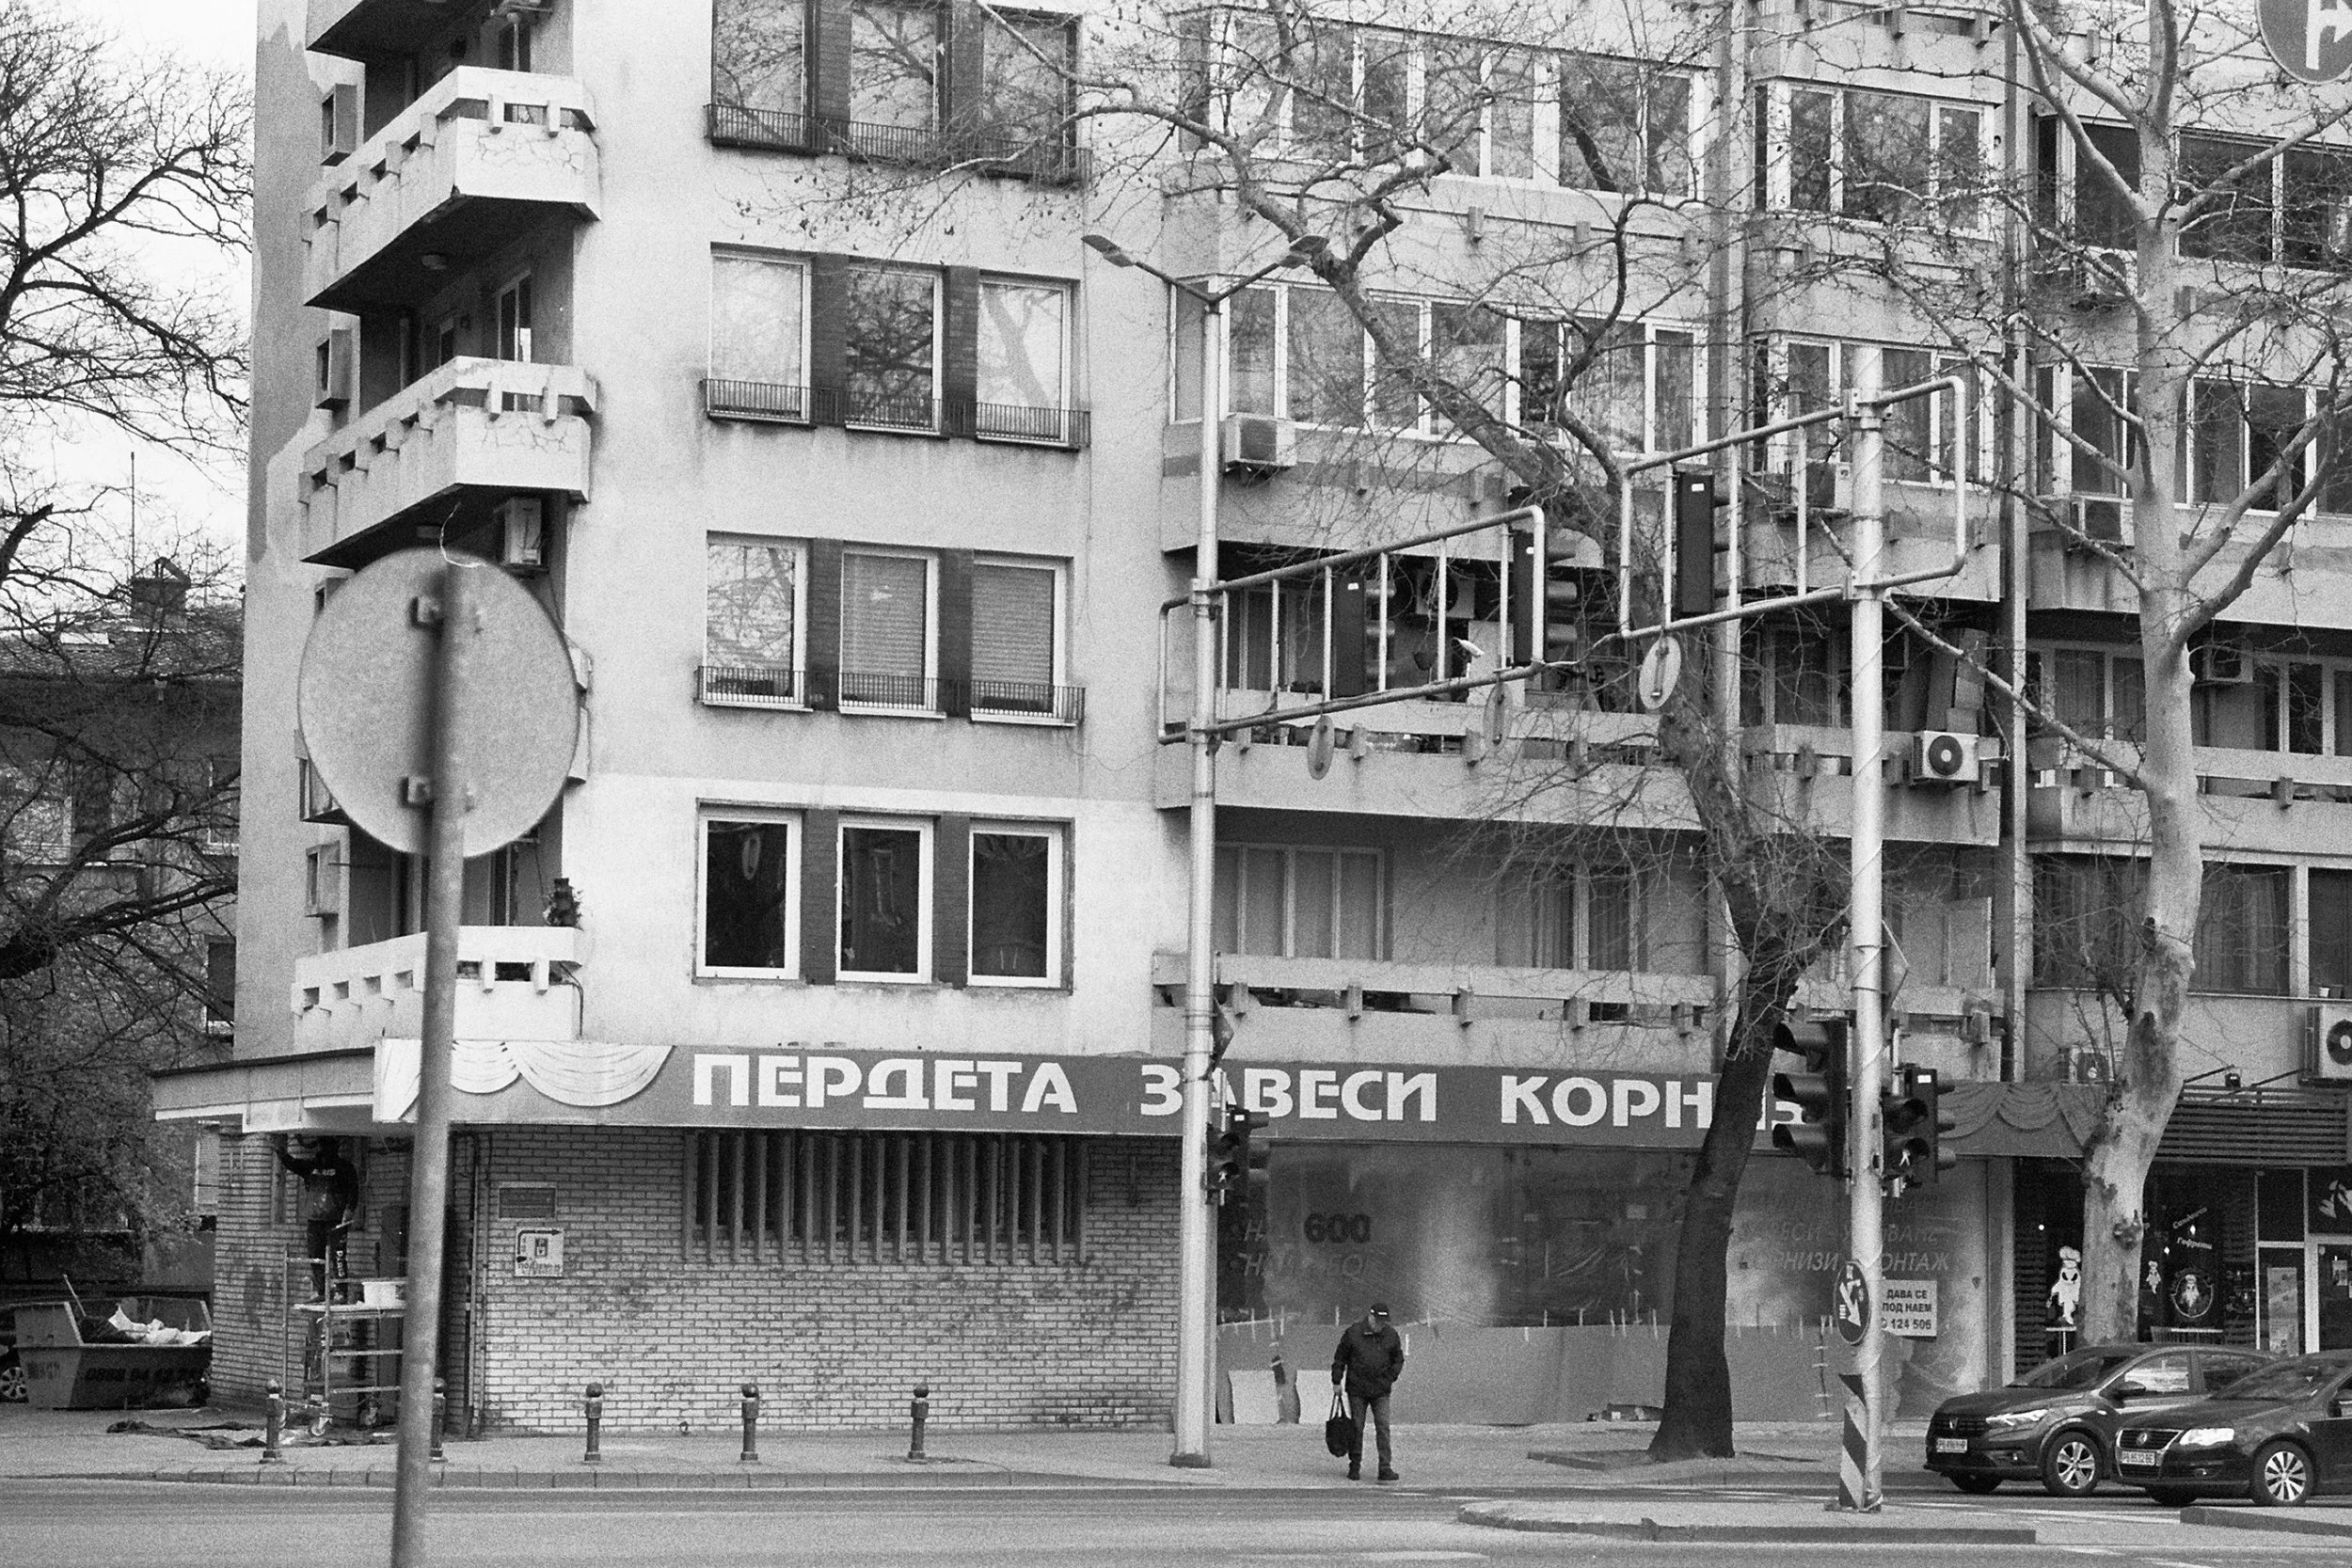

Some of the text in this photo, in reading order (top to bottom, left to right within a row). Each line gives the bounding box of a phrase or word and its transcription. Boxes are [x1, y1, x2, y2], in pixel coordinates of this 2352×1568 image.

[693, 1053, 1078, 1114] ПЕРДЕТА
[1882, 1252, 1950, 1272] ОНТАЖ
[1886, 1290, 1928, 1300] ДАВА СЕ
[1882, 1302, 1932, 1313] ПОД НАЕМ
[1891, 1319, 1910, 1329] 124
